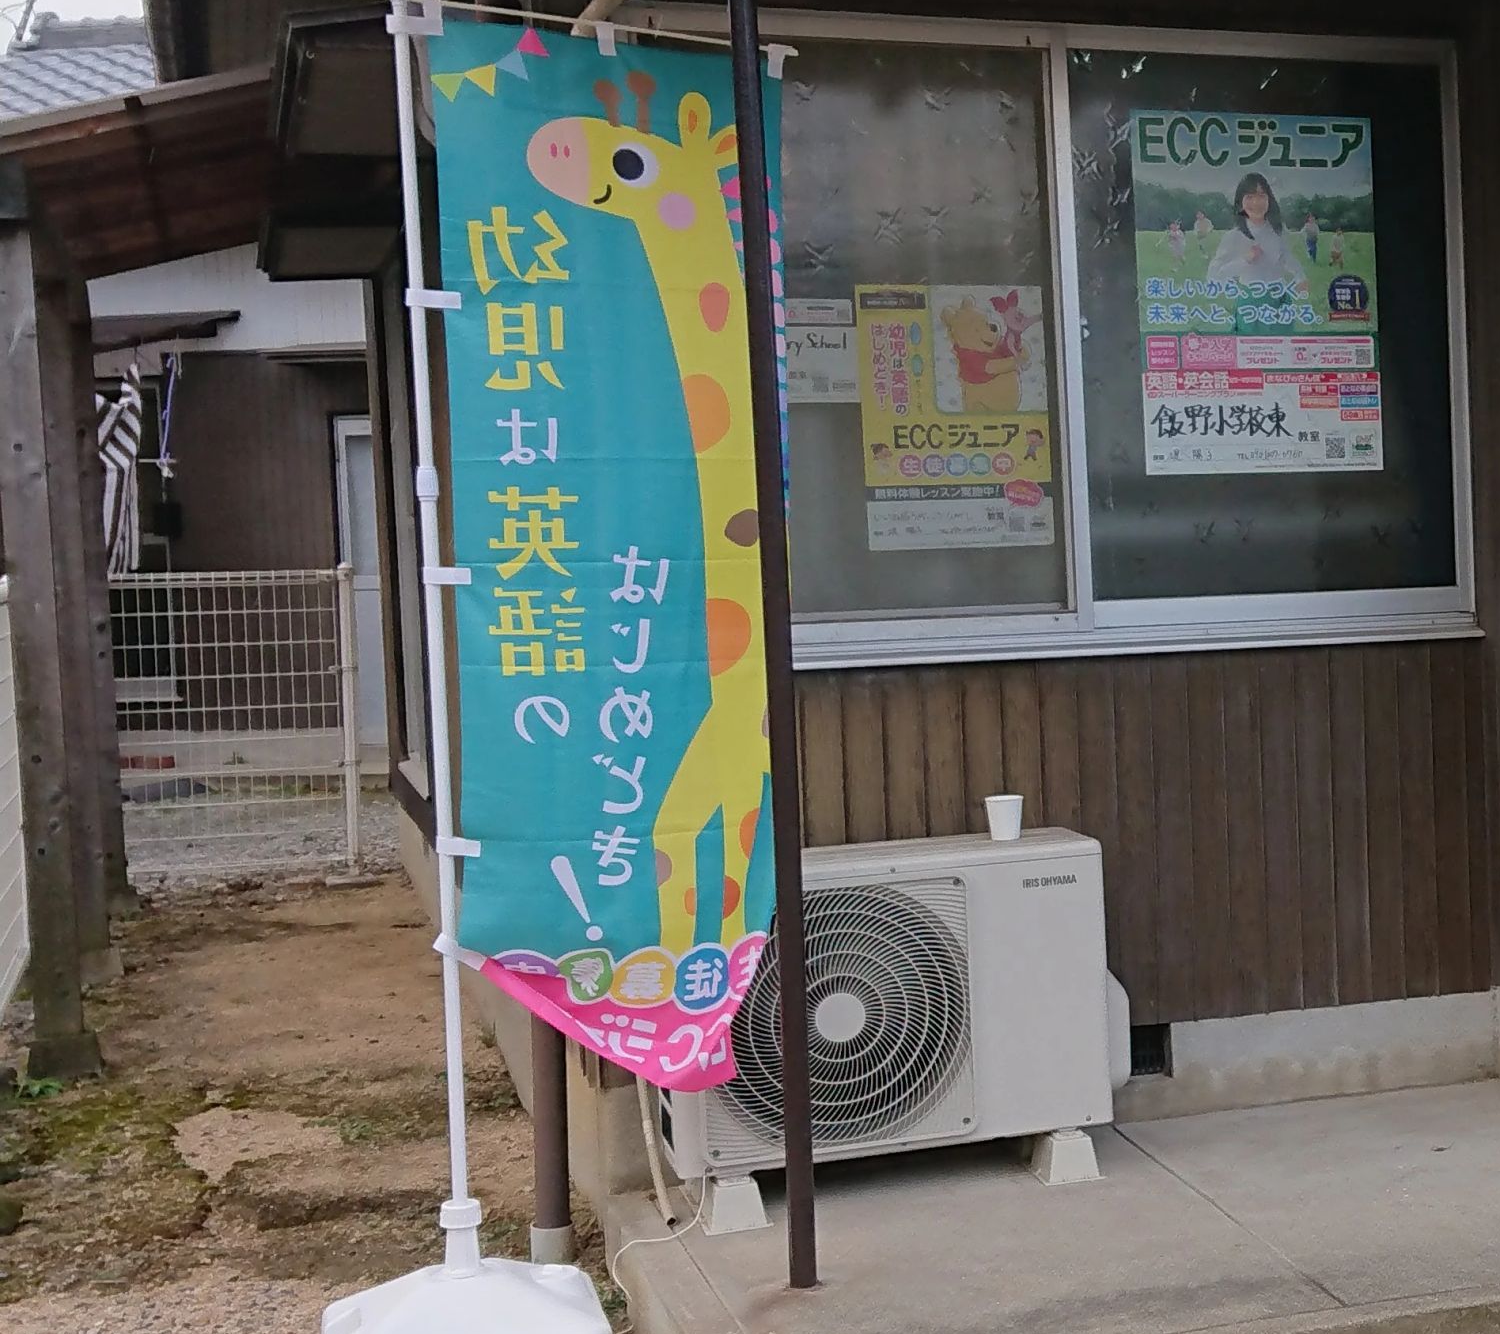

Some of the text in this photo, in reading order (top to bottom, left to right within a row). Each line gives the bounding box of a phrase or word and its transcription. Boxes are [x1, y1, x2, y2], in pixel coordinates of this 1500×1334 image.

[1138, 117, 1364, 168] ECCジュニア
[1150, 402, 1293, 438] 飯野小学校東
[893, 424, 1020, 450] ECCジュニア
[1022, 873, 1078, 889] IRIS OHYAMA
